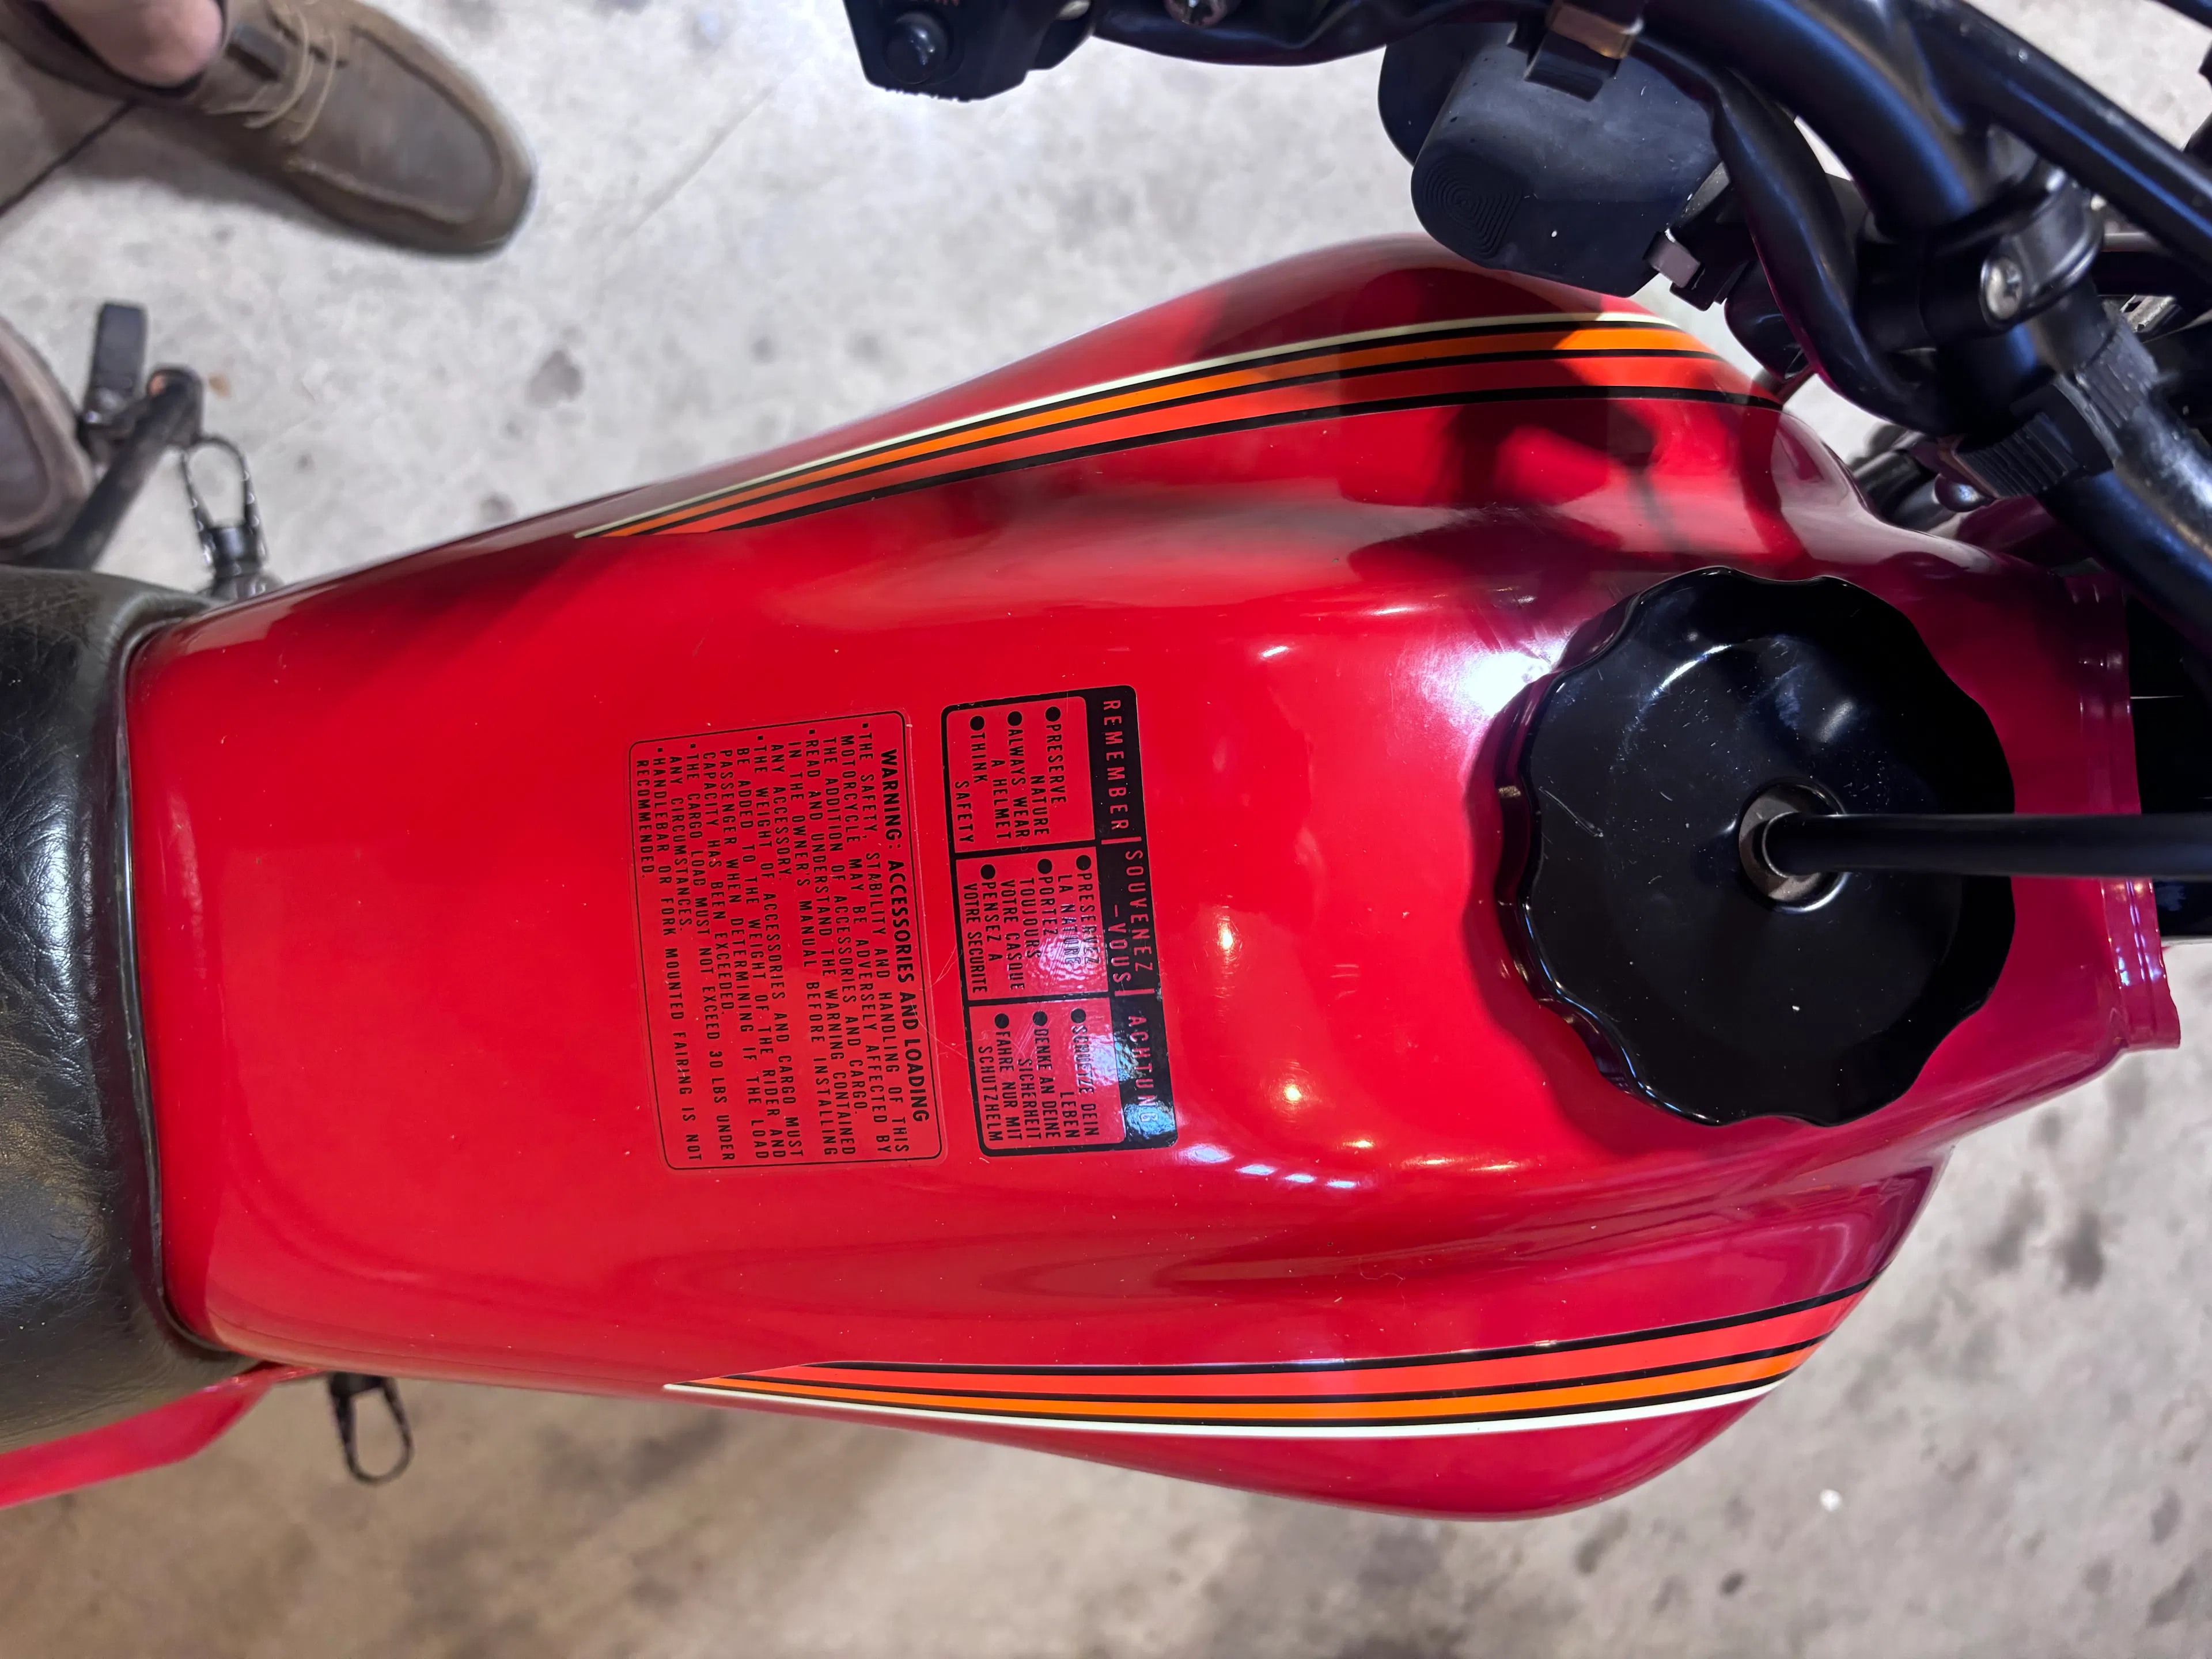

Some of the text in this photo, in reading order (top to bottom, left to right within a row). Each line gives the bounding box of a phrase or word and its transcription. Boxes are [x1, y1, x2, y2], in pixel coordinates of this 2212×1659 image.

[771, 744, 792, 881] ANY ACCESSORY.
[955, 781, 974, 842] SAFETY
[970, 732, 988, 783] THINK
[993, 778, 1012, 839] HELMET
[1008, 729, 1030, 838] ALWAYS WEAR
[1030, 775, 1050, 835] NATURE
[1046, 724, 1066, 804] PRESERVE
[1103, 700, 1129, 830] REMEMBER
[636, 760, 655, 877] RECOMMENDED.
[669, 756, 692, 931] ANY CIRCUMSTANCES.
[703, 752, 734, 1014] CAPACITY HAS BEEN EXCEEDED.
[823, 737, 868, 1114] THE ADDITION OF ACCESSORIES AND CARGO.
[880, 748, 929, 1122] WARNING: ACCESSORIES AND LOADING
[963, 882, 987, 993] VOTRE SECURITE
[981, 881, 1003, 961] PENSEZ A
[1001, 880, 1025, 990] VOTRE CASQUE
[1020, 877, 1041, 958] TOUJOURS
[1038, 876, 1058, 935] PORTEZ
[1058, 874, 1081, 967] LA NATURE
[1076, 872, 1100, 966] PRESERVEZ
[1125, 850, 1153, 972] SOUVENEZ
[653, 757, 702, 1160] HANDLEBAR OR FORK MOUNTED FAIRING IS NOT
[686, 753, 735, 1160] THE CARGO LOAD MUST NOT EXCEED 30 LBS UNDER
[719, 749, 769, 1158] PASSENGER WHEN DETERMINING IF THE LOAD
[736, 747, 786, 1157] BE ADDED TO THE WEIGHT OF THE RIDER AND
[753, 745, 804, 1156] THE WEIGHT OF ACCESSORIES AND CARGO MUST
[788, 741, 838, 1155] IN THE OWNER'S MANUAL BEFORE INSTALLING
[805, 739, 855, 1154] READ AND UNDERSTAND THE WARNING CONTAINED
[840, 734, 892, 1152] MOTORCYCLE MAY BE ADVERSELY AFFECTED BY
[858, 732, 909, 1152] THE SAFETY, STABILITY AND HANDLING OF THIS
[978, 1046, 1003, 1141] SCHUTZHELM
[996, 1031, 1022, 1139] FAHRE NUR MIT
[1018, 1058, 1041, 1139] SICHERHEIT
[1033, 1028, 1060, 1138] DENKE AN DEINE
[1060, 1092, 1080, 1138] LEBEN
[1071, 1025, 1099, 1135] SCHUETZE DEIN
[1127, 1015, 1160, 1124] ACHTUNG
